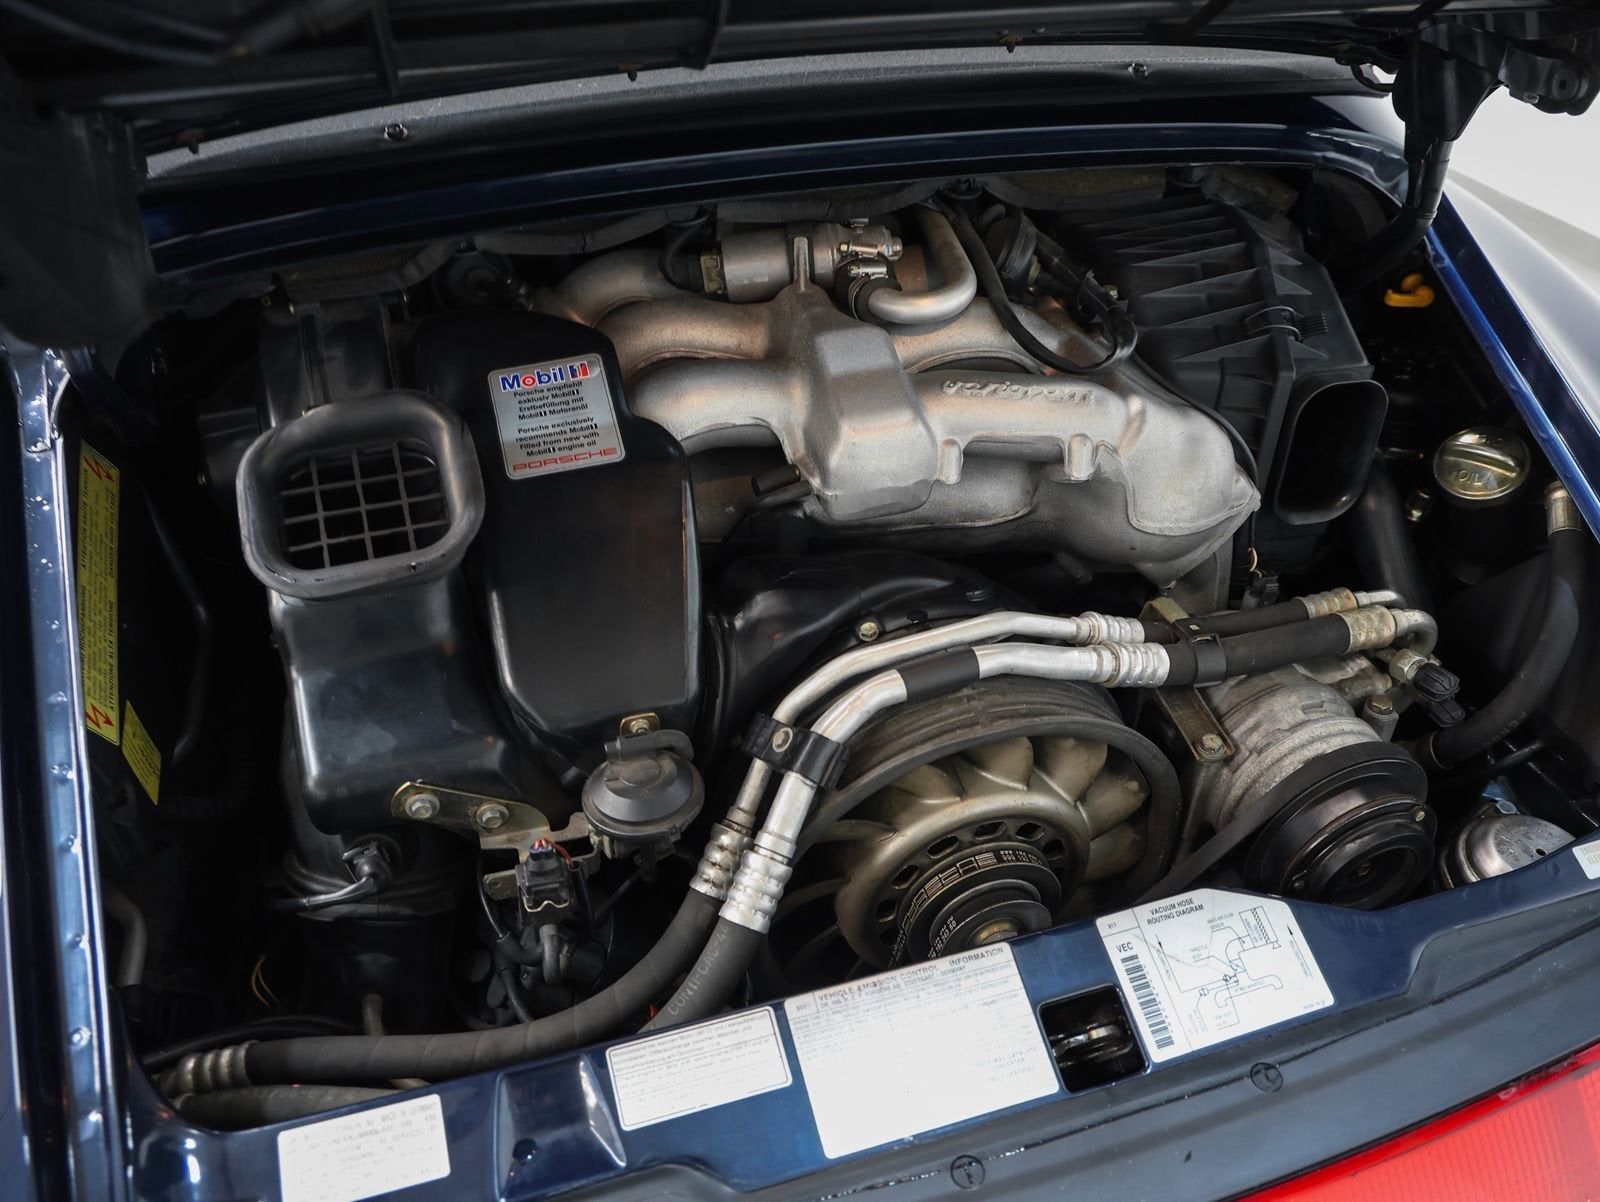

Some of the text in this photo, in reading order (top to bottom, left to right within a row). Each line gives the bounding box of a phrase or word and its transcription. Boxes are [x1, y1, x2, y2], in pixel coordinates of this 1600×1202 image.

[500, 366, 565, 392] Mobil
[514, 381, 583, 398] Porsche empfiehlt
[518, 395, 549, 405] exklusiv
[519, 396, 584, 413] Erstbefüllung mit
[549, 404, 588, 416] Motorenöl
[518, 416, 594, 434] Porsche exclusively
[516, 430, 567, 443] recommends
[520, 431, 600, 450] Filled from new with
[557, 442, 585, 452] engine
[587, 439, 597, 447] oil
[513, 447, 617, 472] PORSCHE
[1146, 903, 1205, 926] ROUTING DIAGRAM
[1150, 897, 1195, 916] VACUUM HOSE
[1116, 941, 1134, 953] VEC
[817, 946, 1004, 1001] VEHICLE EMISSION CONTROL INFORMATION
